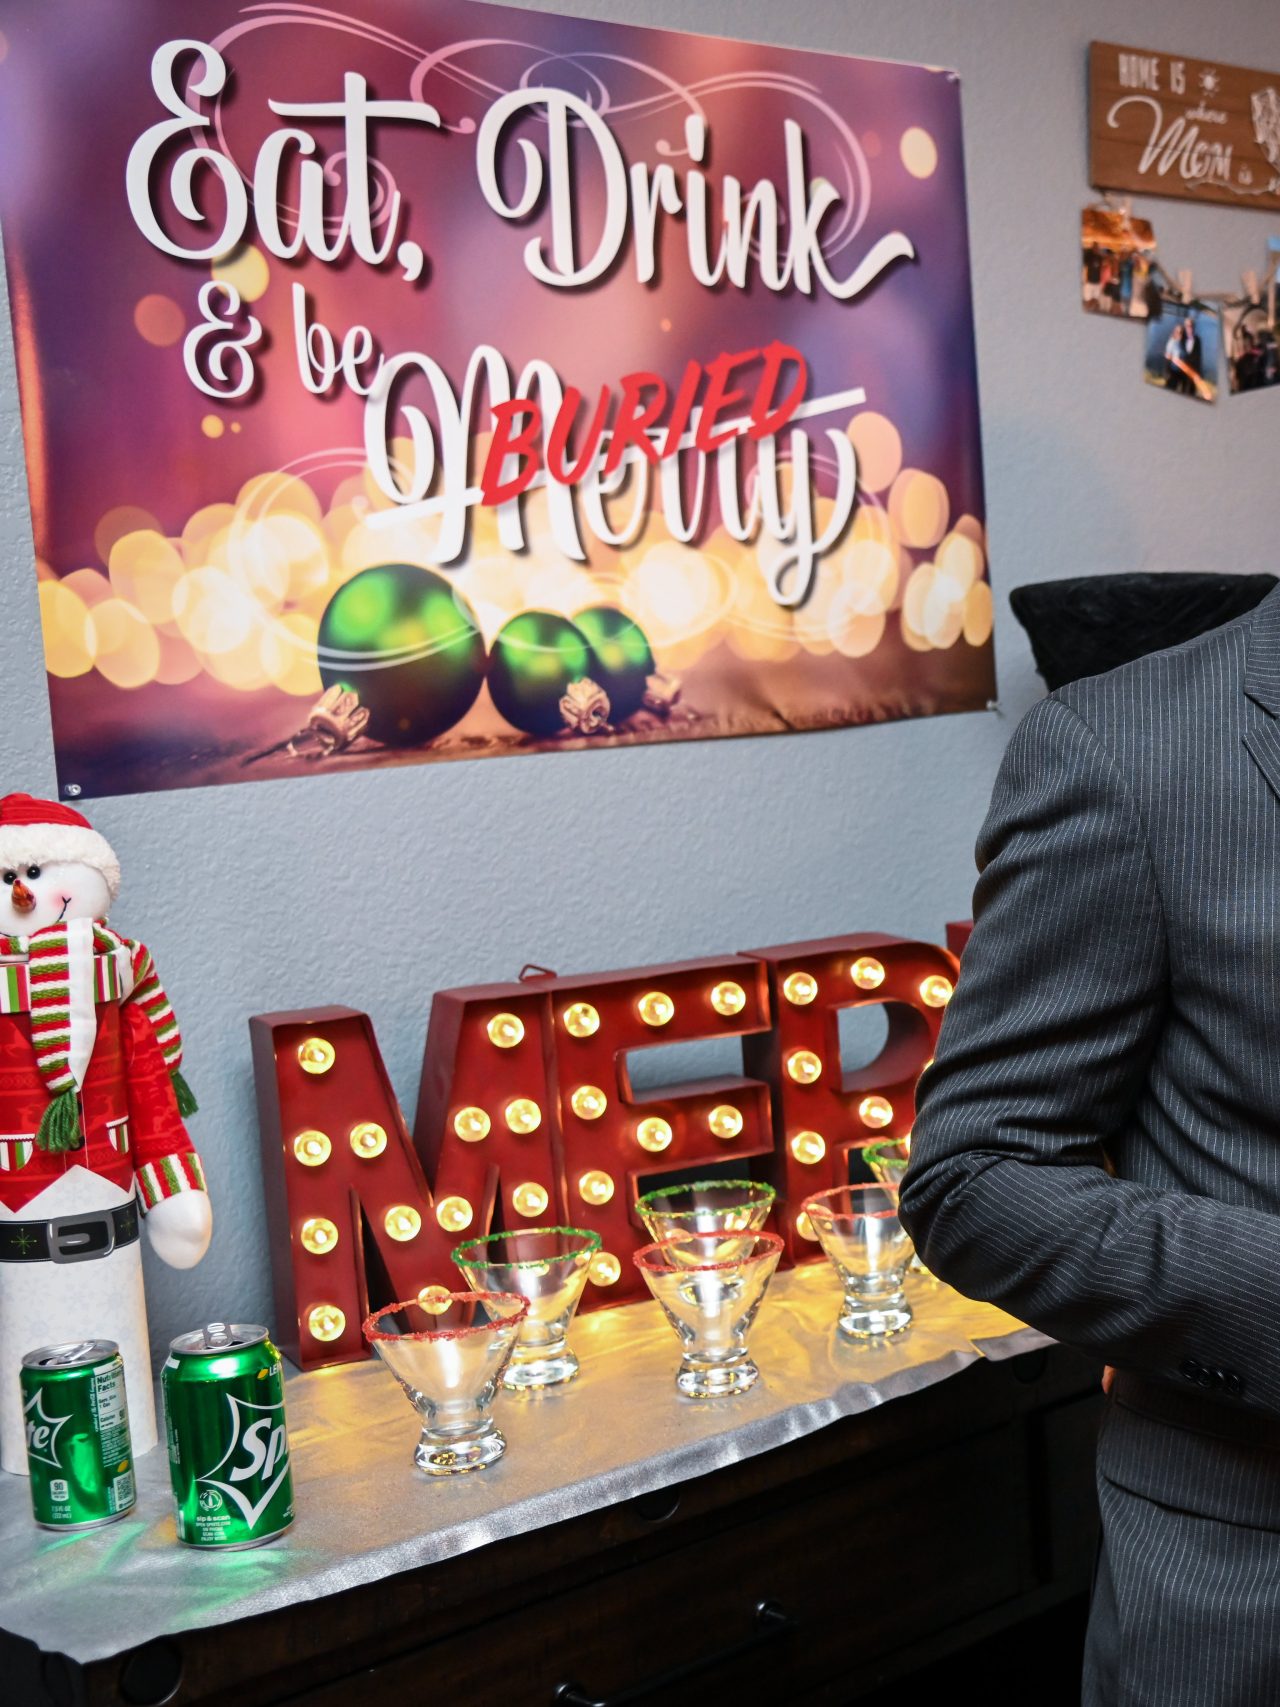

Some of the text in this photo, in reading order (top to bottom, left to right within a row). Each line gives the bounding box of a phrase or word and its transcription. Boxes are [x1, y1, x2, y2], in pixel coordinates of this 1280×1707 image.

[1118, 53, 1185, 95] HOME IS
[125, 39, 914, 300] Eat, Drink
[184, 281, 374, 398] & be
[481, 340, 808, 506] BURIED
[250, 922, 975, 1372] MER
[97, 1382, 116, 1392] Facts
[25, 1416, 51, 1449] te
[229, 1417, 289, 1481] Sp
